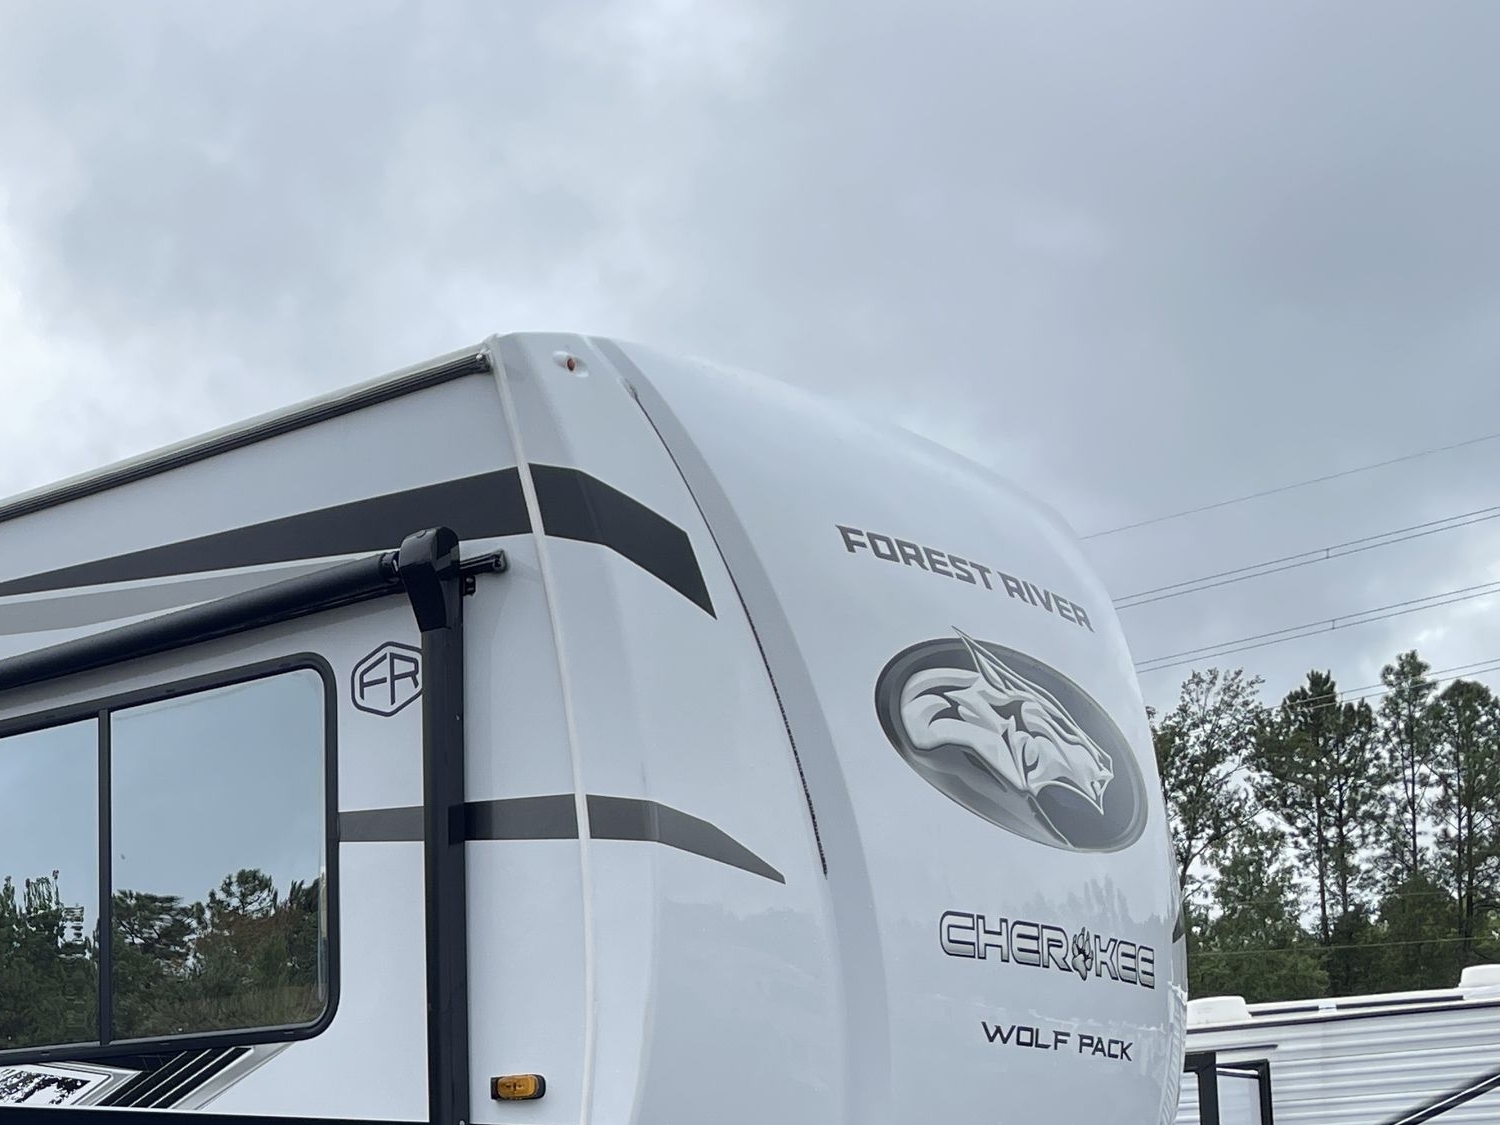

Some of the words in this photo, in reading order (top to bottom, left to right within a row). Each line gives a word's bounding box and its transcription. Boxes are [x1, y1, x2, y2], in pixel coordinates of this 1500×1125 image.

[835, 524, 993, 591] FOREST
[996, 570, 1095, 633] RIVER
[981, 1021, 1071, 1051] WOLF
[1078, 1033, 1133, 1062] PACK
